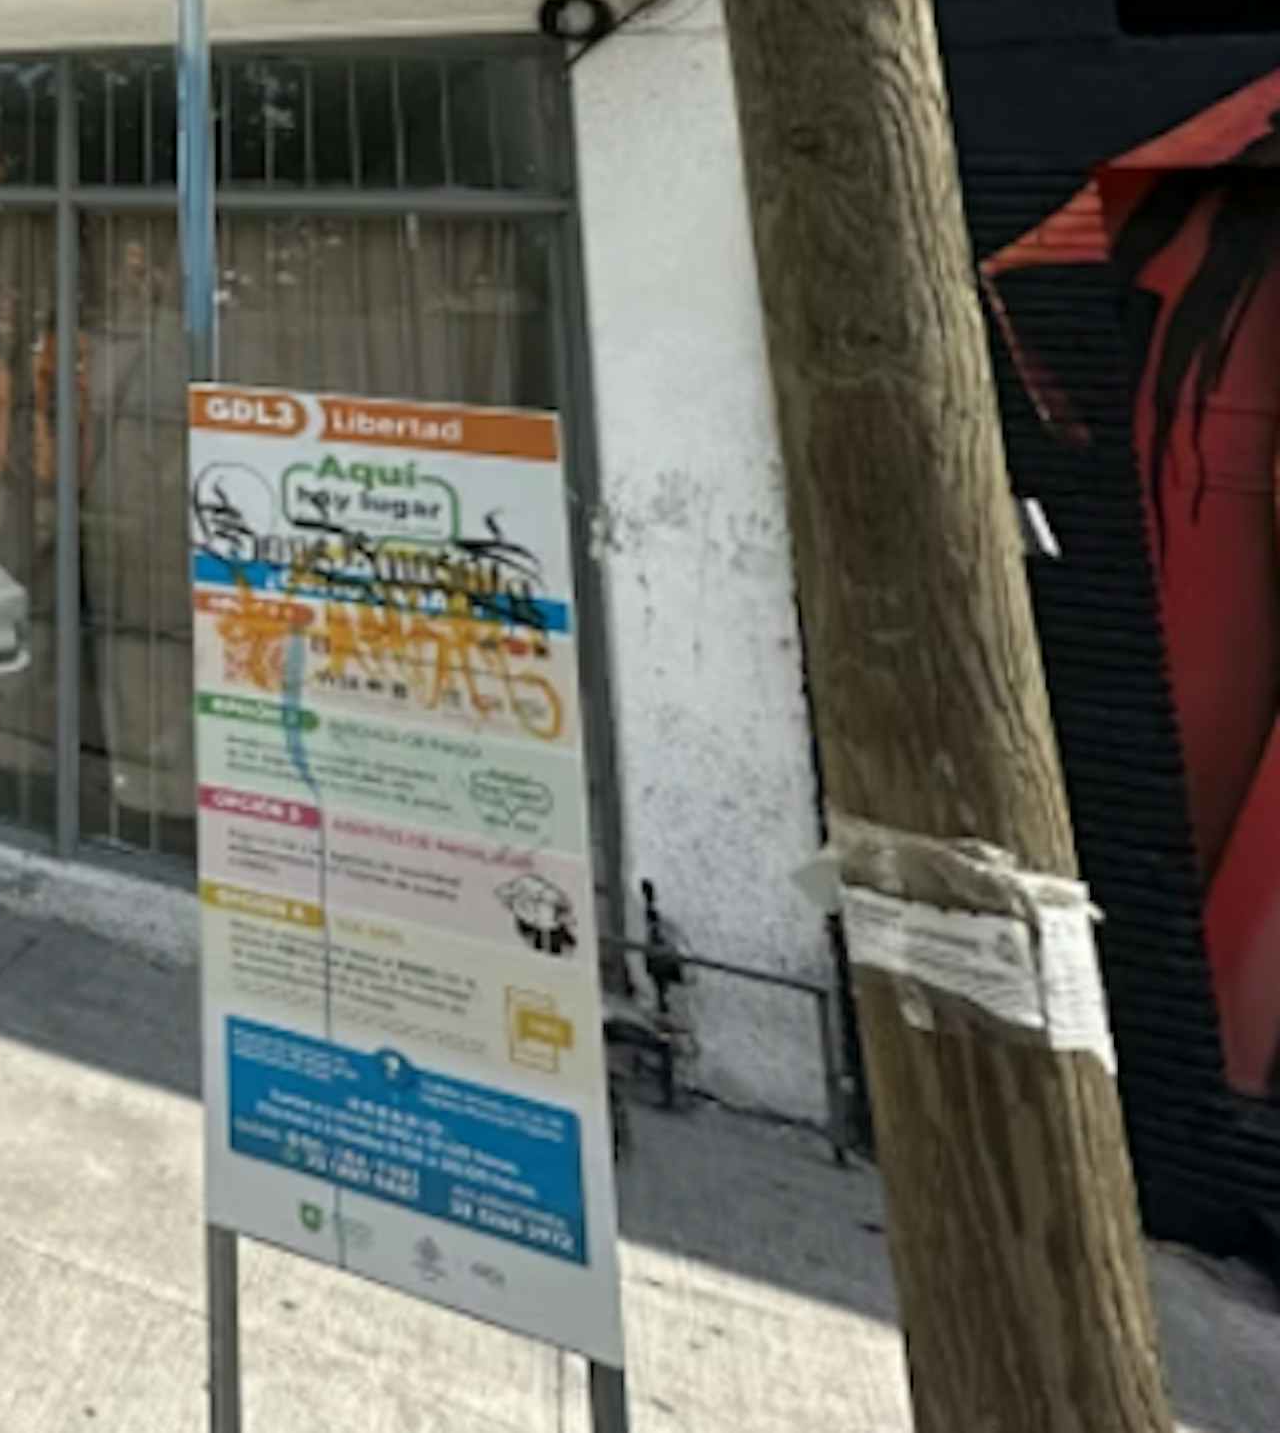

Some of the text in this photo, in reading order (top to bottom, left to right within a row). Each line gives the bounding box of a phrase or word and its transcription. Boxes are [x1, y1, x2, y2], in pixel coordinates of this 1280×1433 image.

[204, 397, 464, 443] GDL3 Libertad
[315, 454, 419, 490] Aquí
[361, 489, 442, 519] lugar
